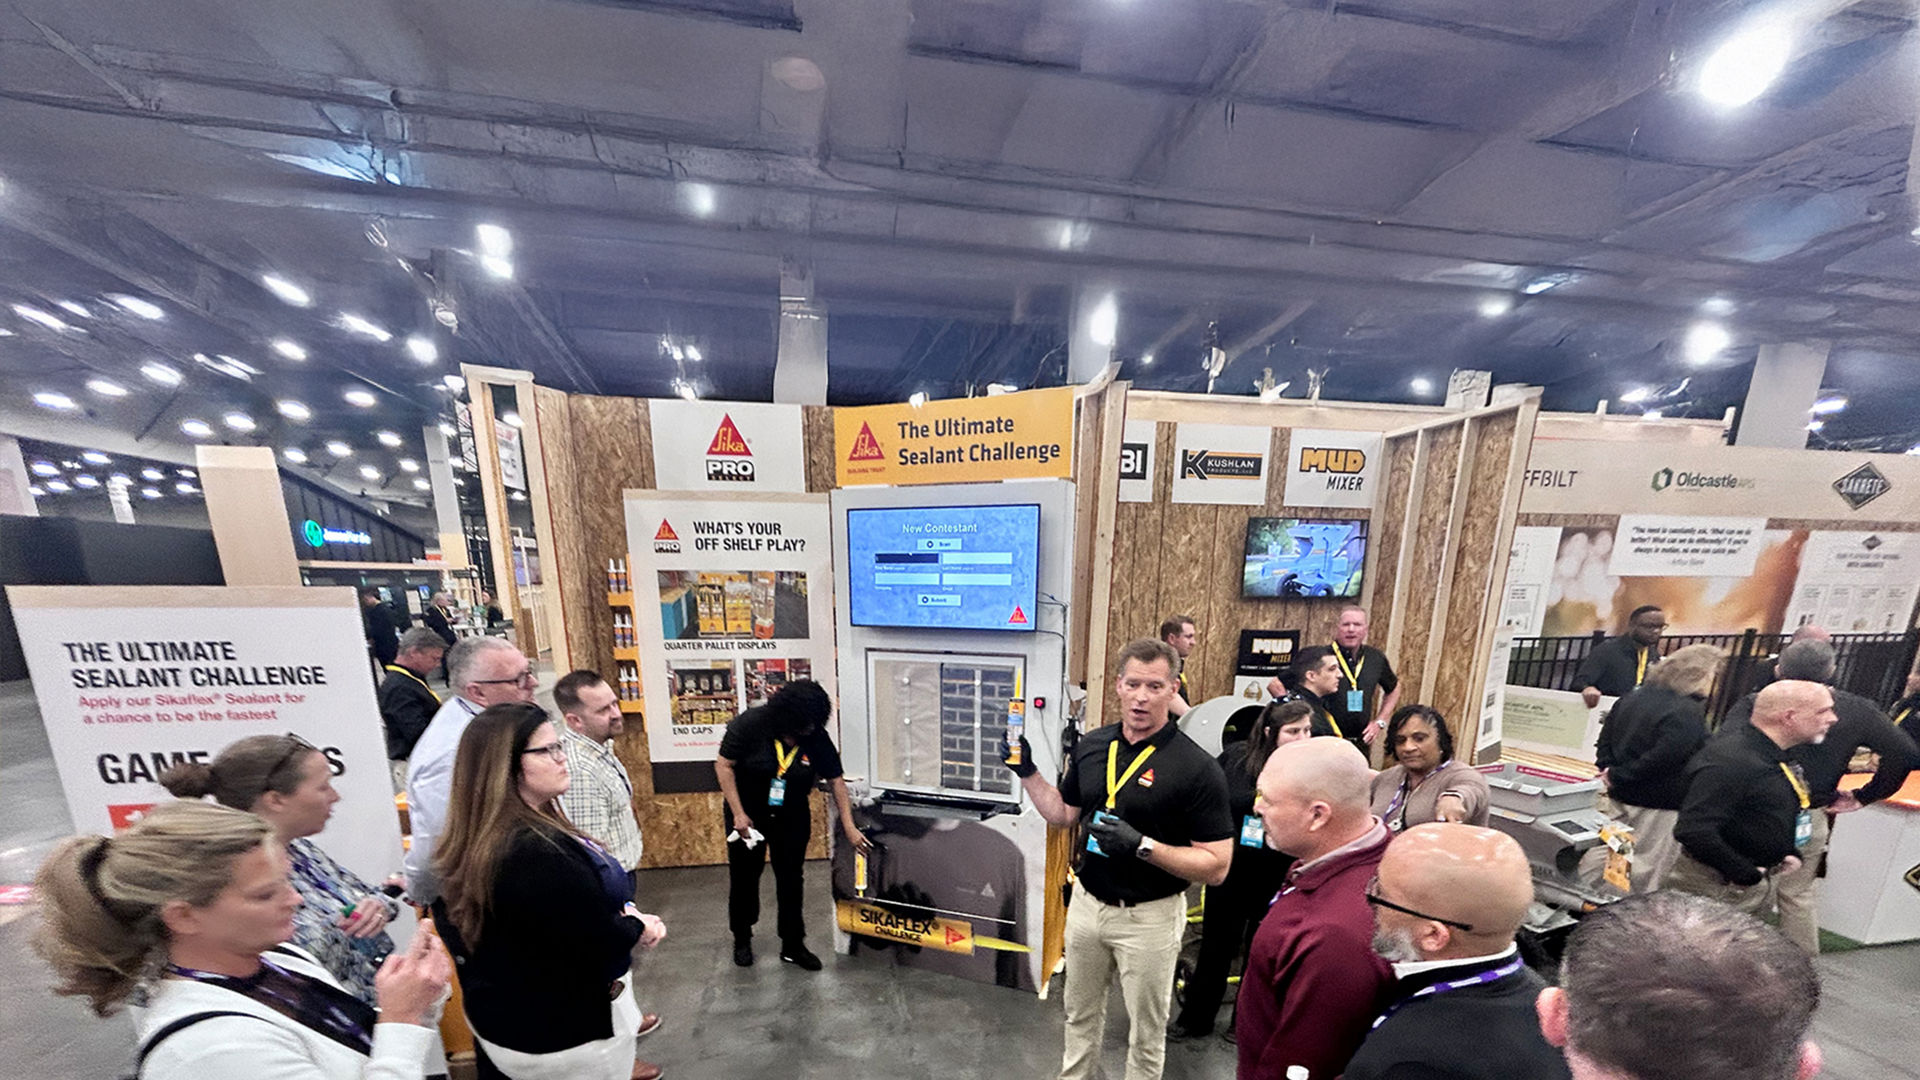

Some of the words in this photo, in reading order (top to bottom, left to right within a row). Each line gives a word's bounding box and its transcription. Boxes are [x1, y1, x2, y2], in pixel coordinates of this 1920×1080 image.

[898, 421, 930, 438] The
[934, 416, 1014, 437] Ultimate
[712, 427, 745, 452] Sika
[899, 447, 965, 466] Sealant
[969, 443, 1060, 463] Challenge
[1299, 447, 1366, 474] MUD
[708, 461, 753, 475] PRO
[1207, 459, 1254, 468] KUSHLAN
[1326, 476, 1364, 490] MIXER
[1676, 472, 1738, 488] Oldcastle
[693, 521, 744, 535] WHAT'S
[747, 522, 782, 535] YOUR
[902, 524, 923, 534] New
[925, 523, 977, 533] Contestant
[695, 538, 719, 551] OFF
[723, 538, 763, 551] SHELF
[767, 539, 806, 552] PLAY?
[62, 642, 113, 662] THE
[117, 641, 237, 661] ULTIMATE
[664, 642, 704, 651] QUARTER
[705, 642, 735, 650] PALLET
[737, 641, 777, 650] DISPLAYS
[1251, 638, 1293, 654] MUD
[71, 668, 181, 688] SEALANT
[190, 666, 327, 687] CHALLENGE
[79, 695, 121, 708] Apply
[126, 697, 151, 706] our
[224, 693, 281, 705] Sealant
[284, 692, 305, 703] for
[83, 715, 92, 724] a
[97, 713, 151, 723] chance
[156, 712, 171, 722] to
[175, 712, 194, 721] be
[198, 711, 222, 720] the
[226, 710, 277, 720] fastest
[672, 727, 690, 735] END
[691, 726, 714, 735] CAPS
[874, 926, 922, 942] CHALLENGE
